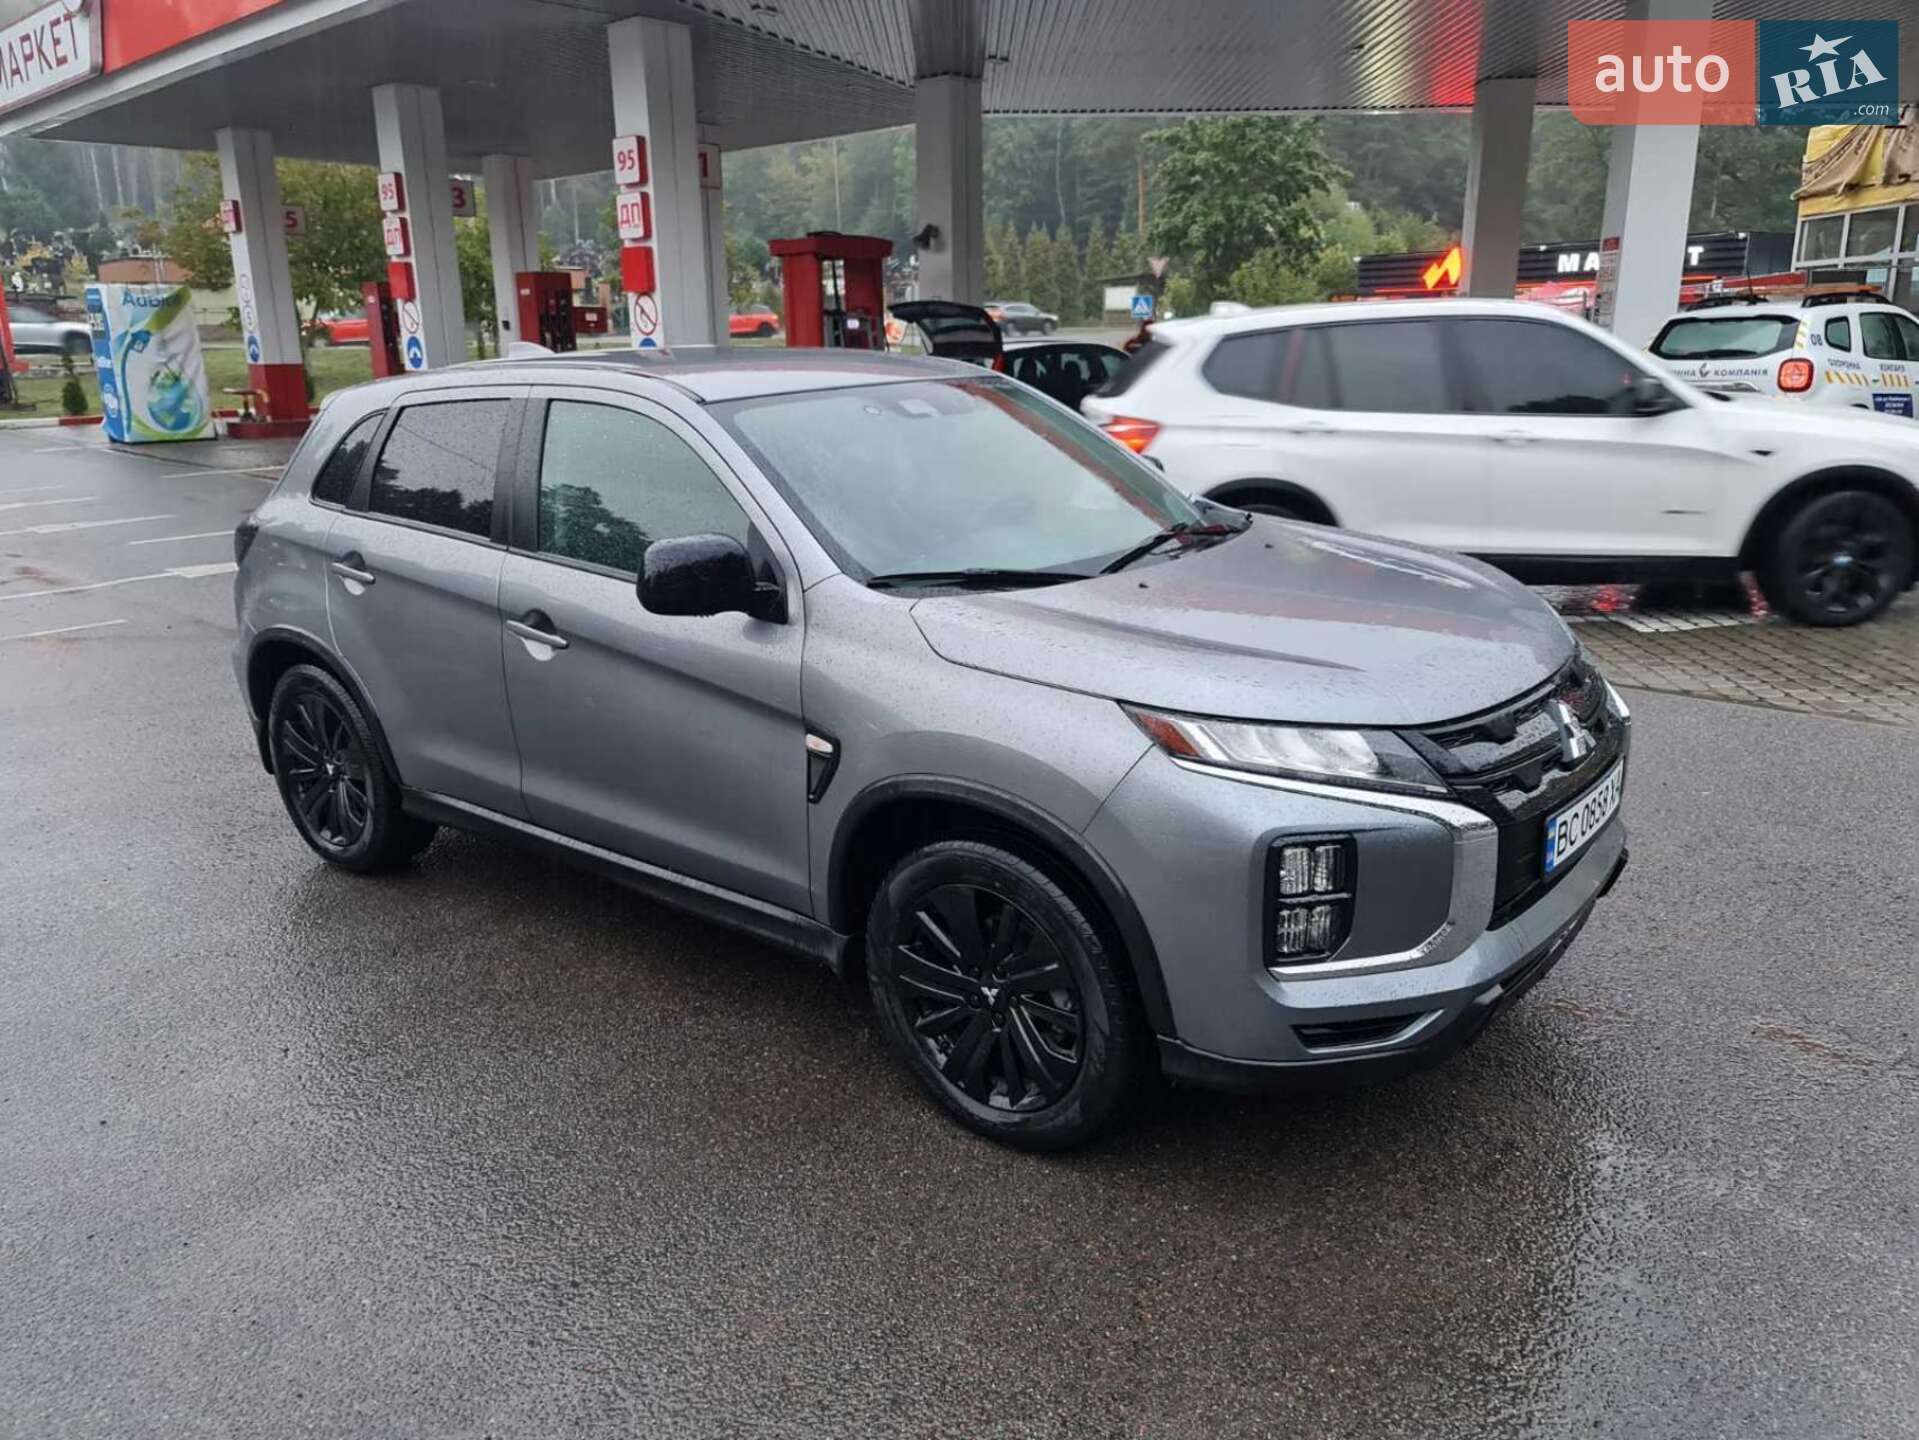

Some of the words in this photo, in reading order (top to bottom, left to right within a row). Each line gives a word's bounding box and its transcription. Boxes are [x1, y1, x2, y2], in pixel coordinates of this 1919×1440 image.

[617, 150, 635, 171] 95
[382, 183, 395, 200] 95
[451, 187, 466, 209] 3
[285, 210, 298, 229] 5
[620, 203, 641, 229] ДП
[1810, 334, 1823, 346] 08
[1714, 368, 1768, 376] КОМПАНІЯ
[1557, 812, 1579, 857] BC
[1581, 785, 1609, 836] 0858
